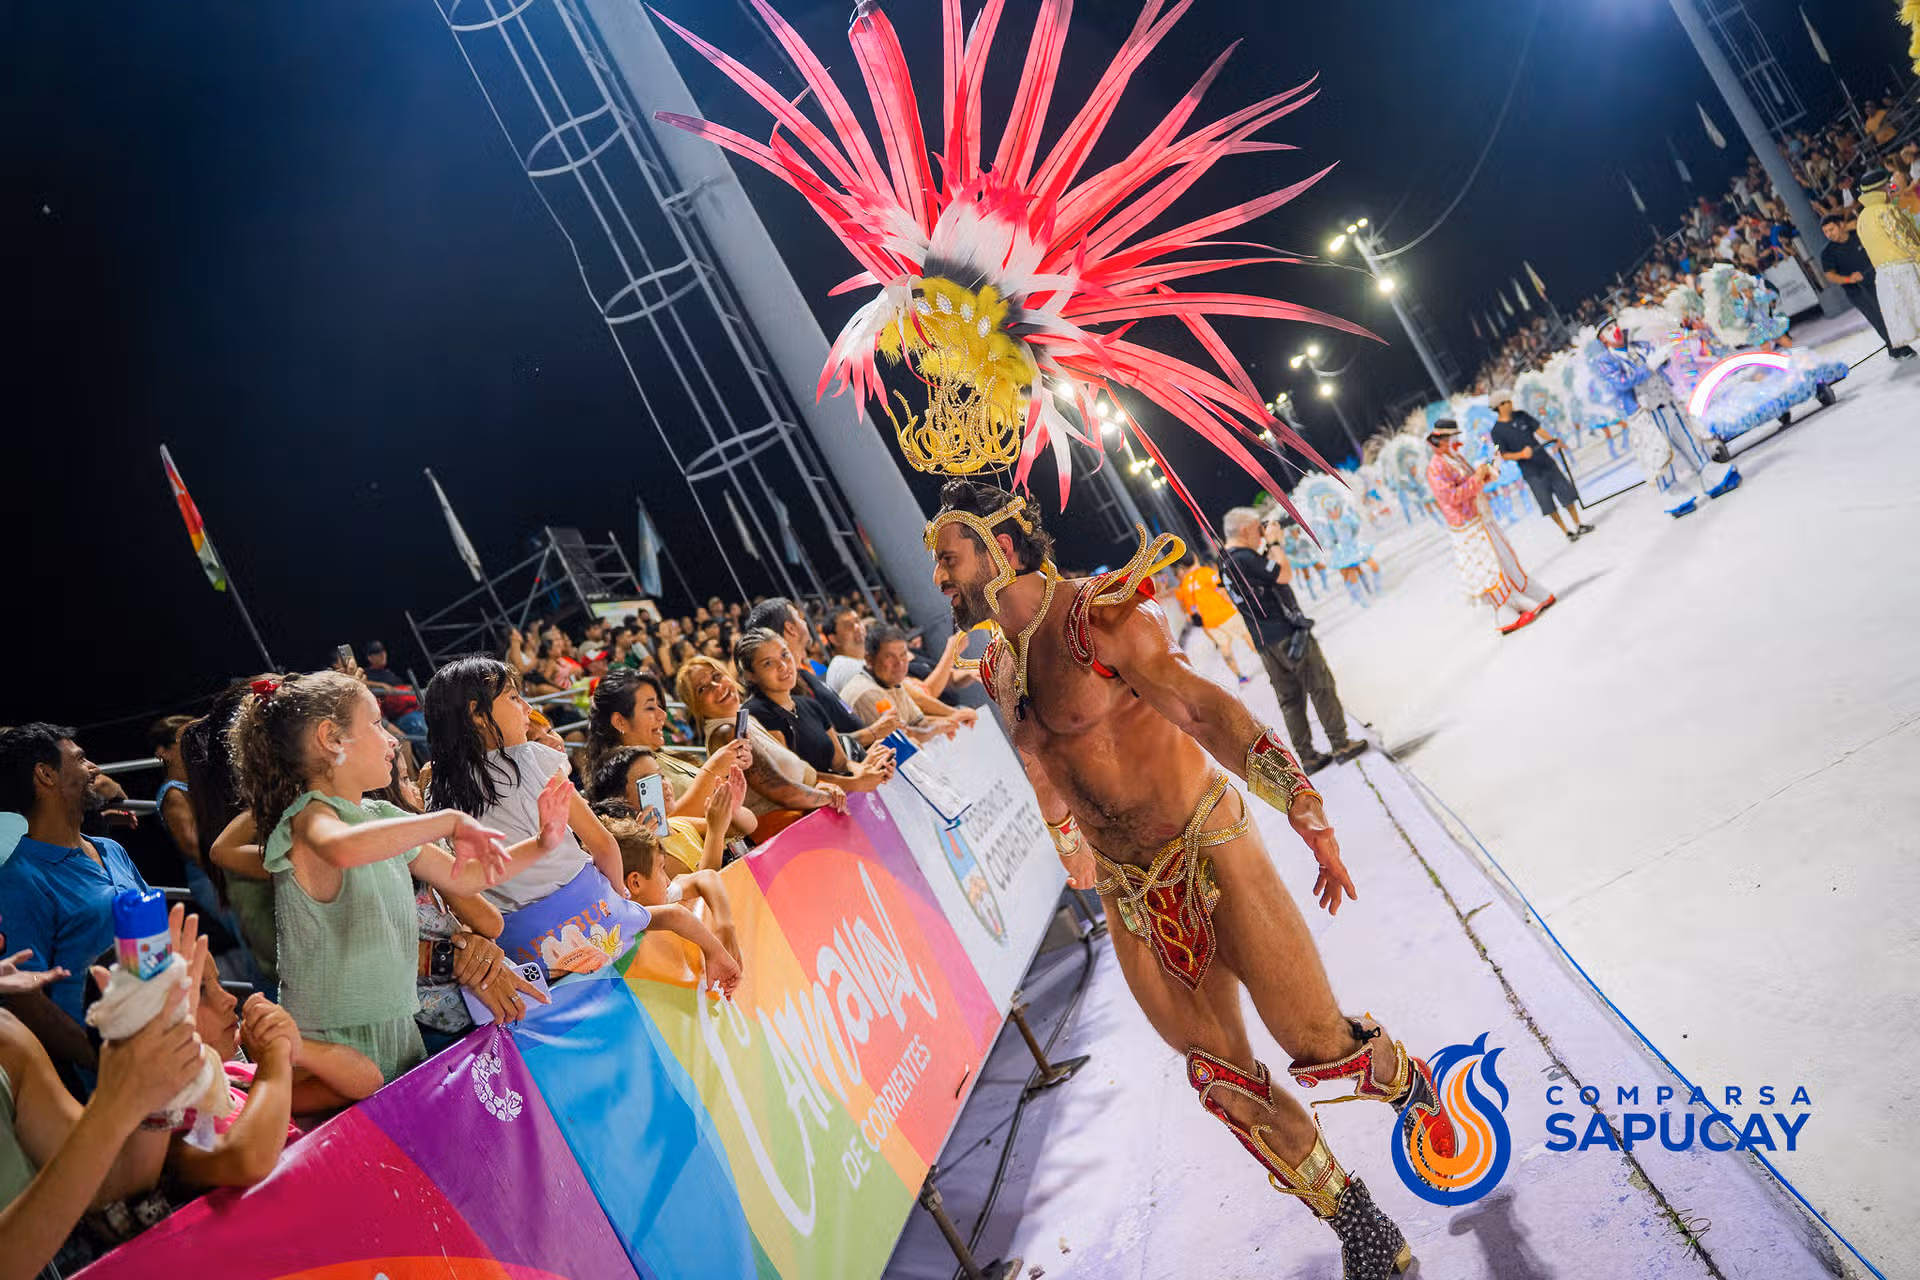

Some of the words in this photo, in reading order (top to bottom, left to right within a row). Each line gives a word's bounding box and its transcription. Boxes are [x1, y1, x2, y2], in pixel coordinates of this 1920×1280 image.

[985, 801, 1045, 892] CORRIENTES
[841, 1134, 871, 1192] DE
[860, 1033, 932, 1153] CORRIENTES
